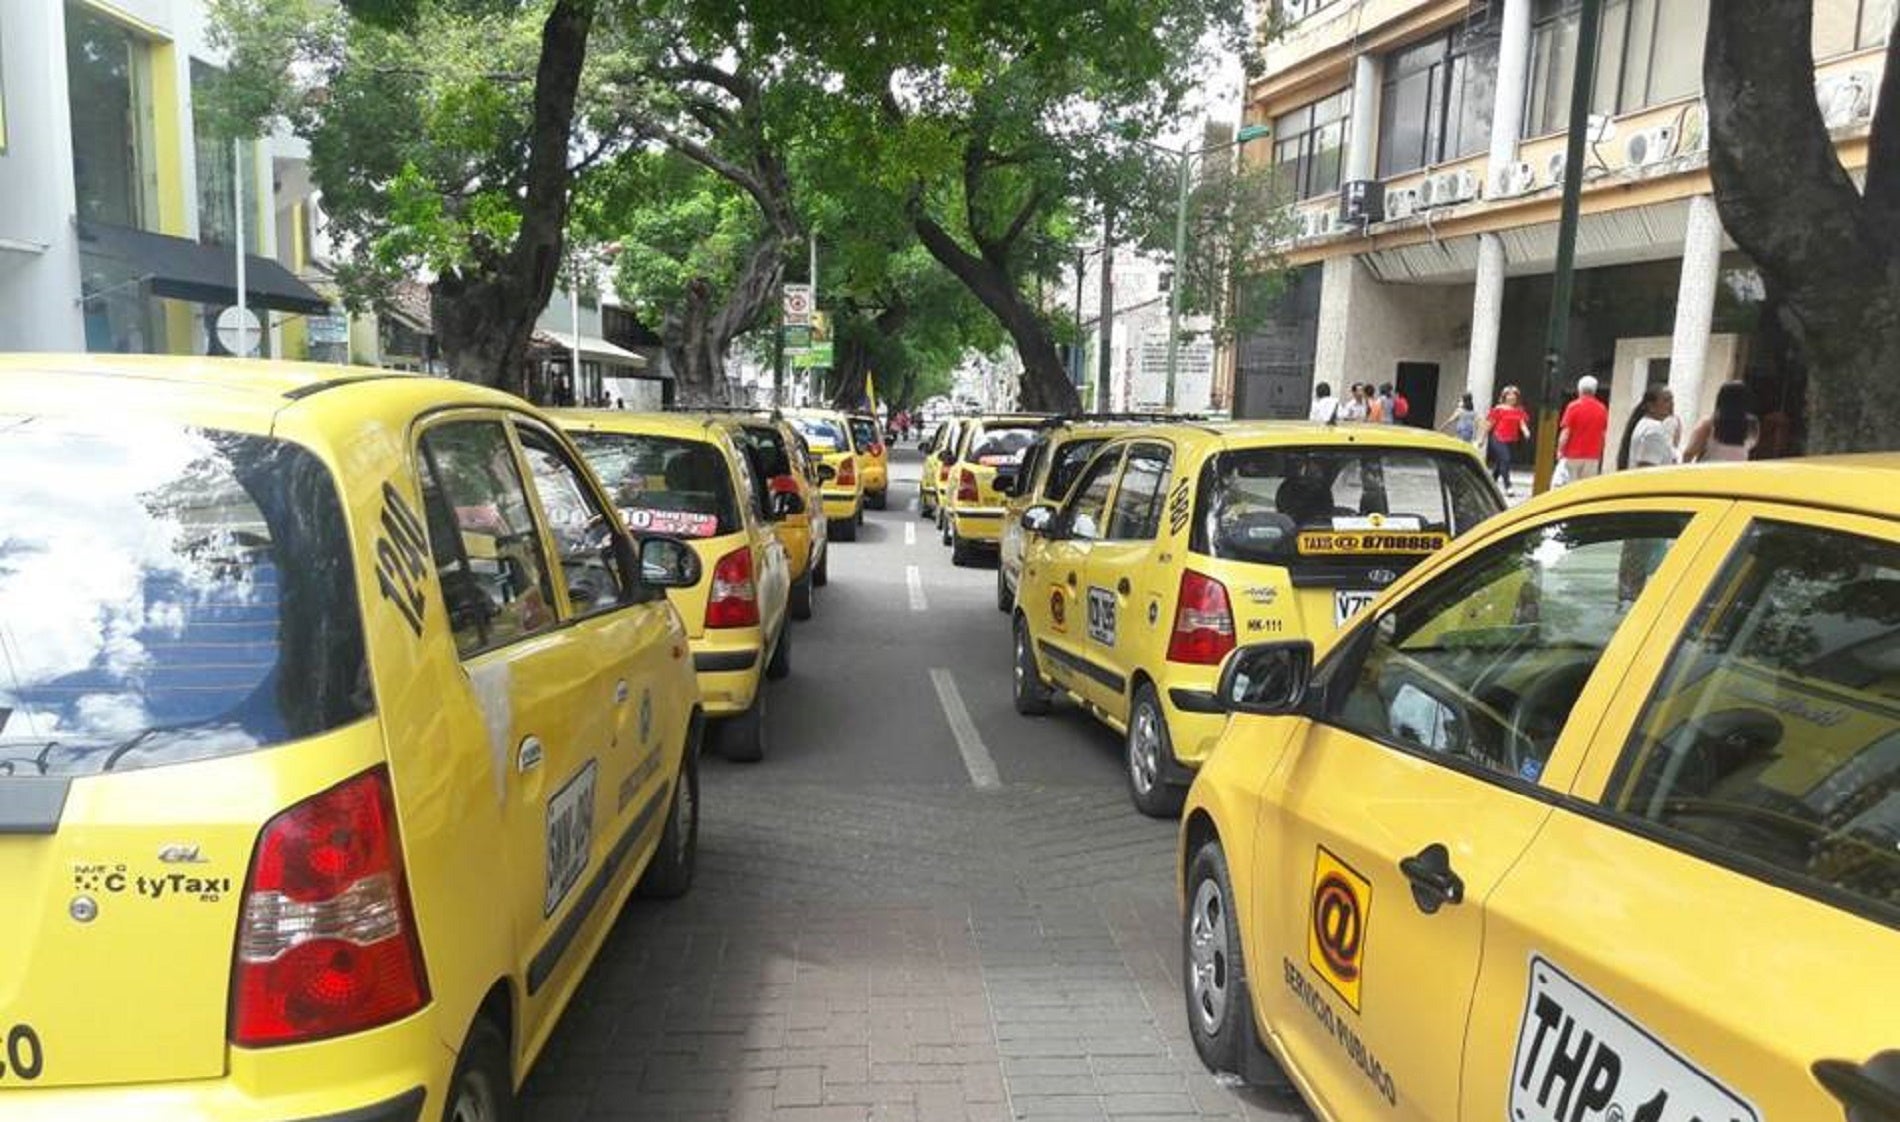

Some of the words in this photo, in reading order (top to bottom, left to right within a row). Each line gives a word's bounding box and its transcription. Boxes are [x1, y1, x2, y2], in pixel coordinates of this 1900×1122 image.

[375, 480, 429, 639] 1240
[1303, 536, 1333, 550] TAXIS
[1283, 955, 1336, 1036] SERVICIO
[1336, 1016, 1397, 1108] PUBLICO
